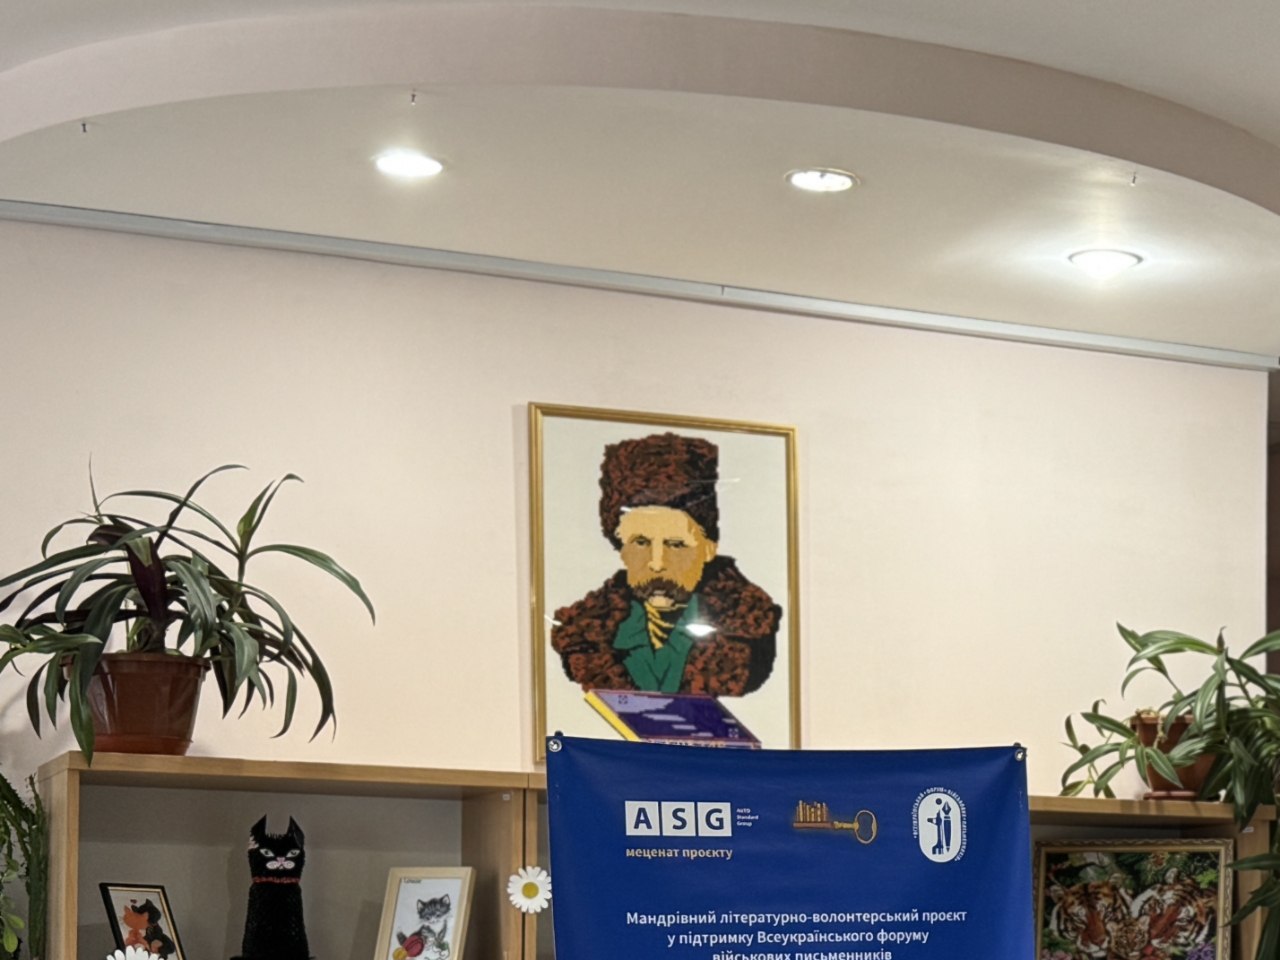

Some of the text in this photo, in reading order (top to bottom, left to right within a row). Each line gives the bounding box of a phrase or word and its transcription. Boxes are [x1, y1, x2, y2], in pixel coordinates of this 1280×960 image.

[626, 848, 733, 860] меценат проєкту
[626, 910, 967, 927] Мандрівний літературно-волонтерський проєкт
[667, 929, 929, 947] у підтримку Всеукраїнського форуму
